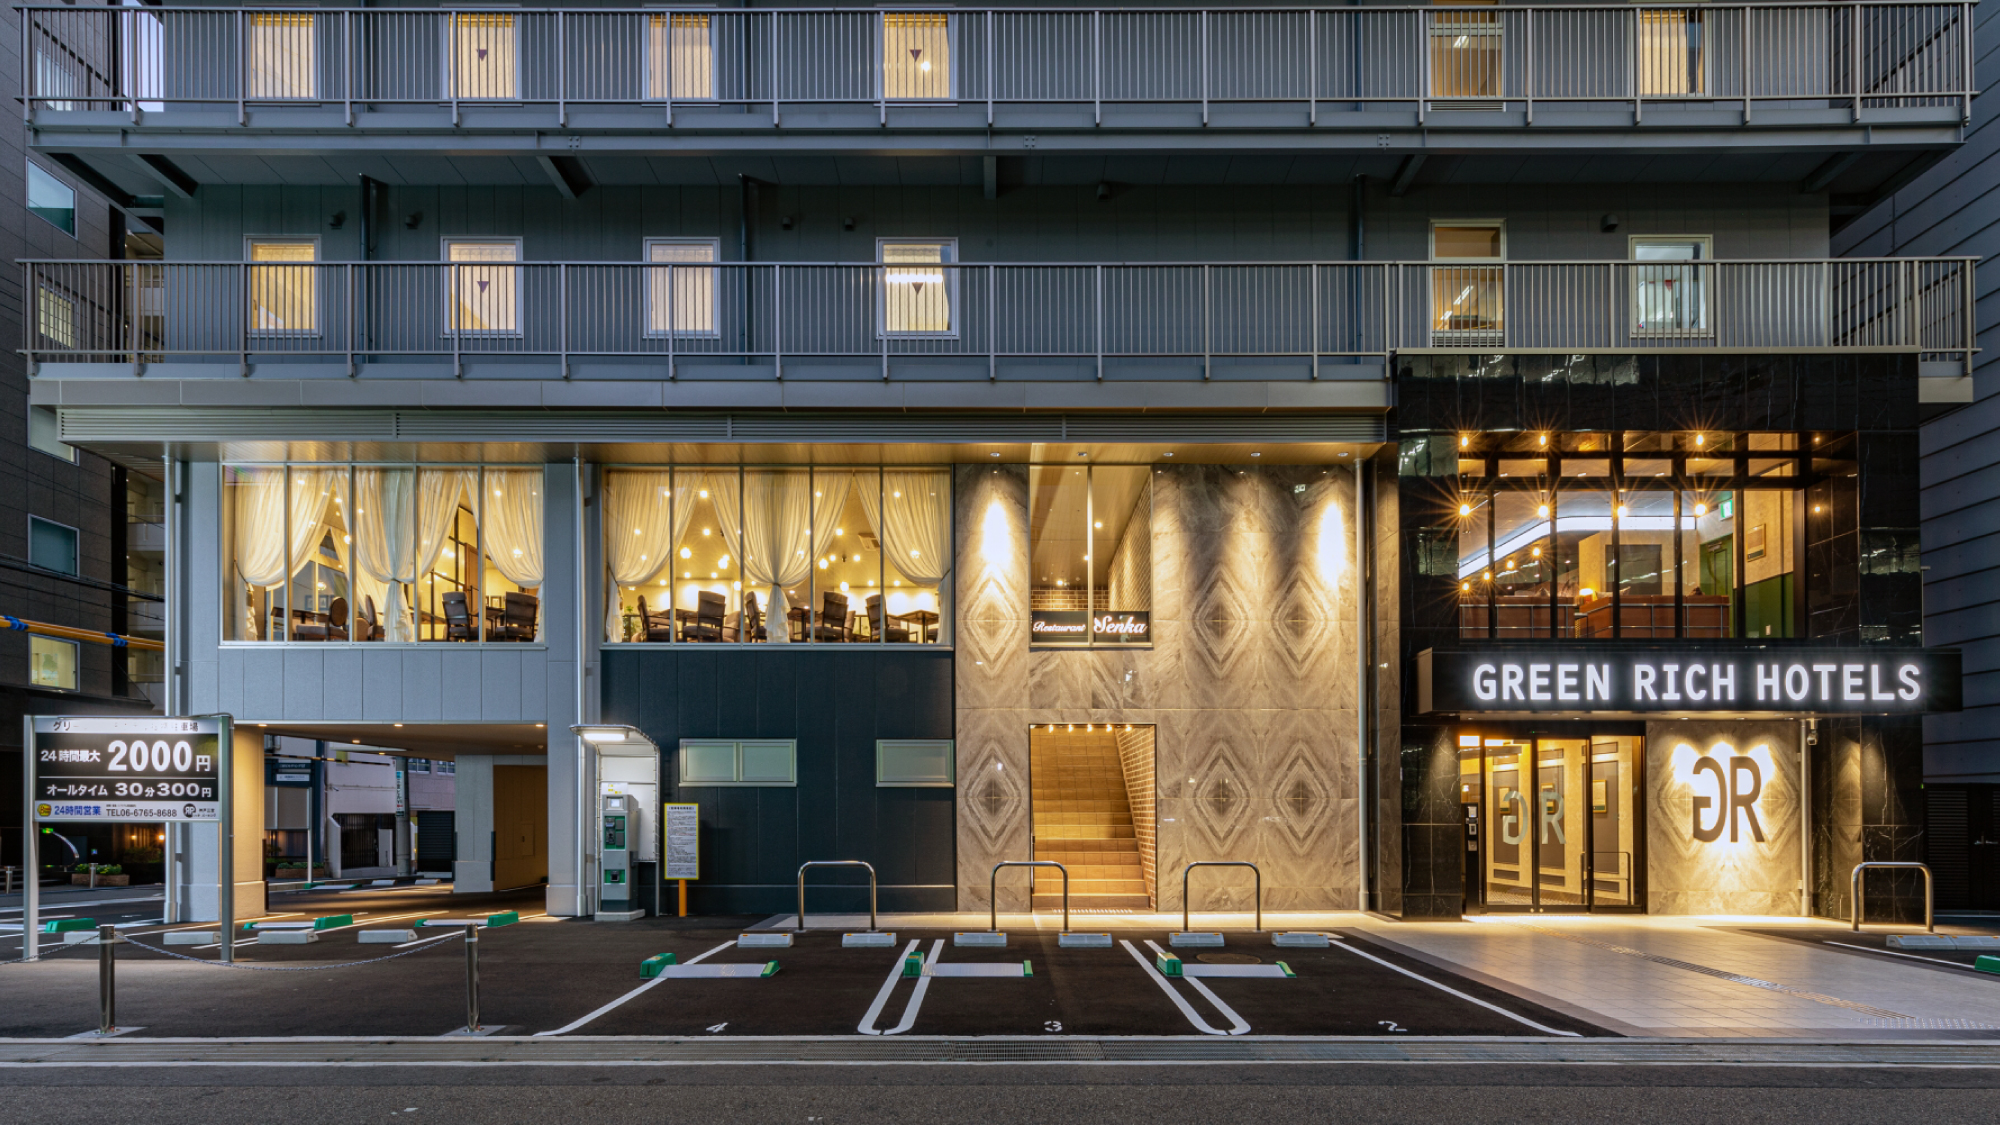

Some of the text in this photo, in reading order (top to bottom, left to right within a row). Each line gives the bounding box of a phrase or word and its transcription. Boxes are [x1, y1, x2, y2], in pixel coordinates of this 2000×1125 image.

[1032, 615, 1148, 633] Restaurant Senka
[1473, 664, 1921, 700] GREEN RICH HOTELS
[47, 784, 108, 796] オールタイム
[54, 805, 101, 816] 24時間営業
[106, 808, 178, 818] TEL06-6765-8688
[706, 1022, 729, 1033] 4
[1044, 1020, 1063, 1032] 3
[1378, 1020, 1408, 1032] 2
